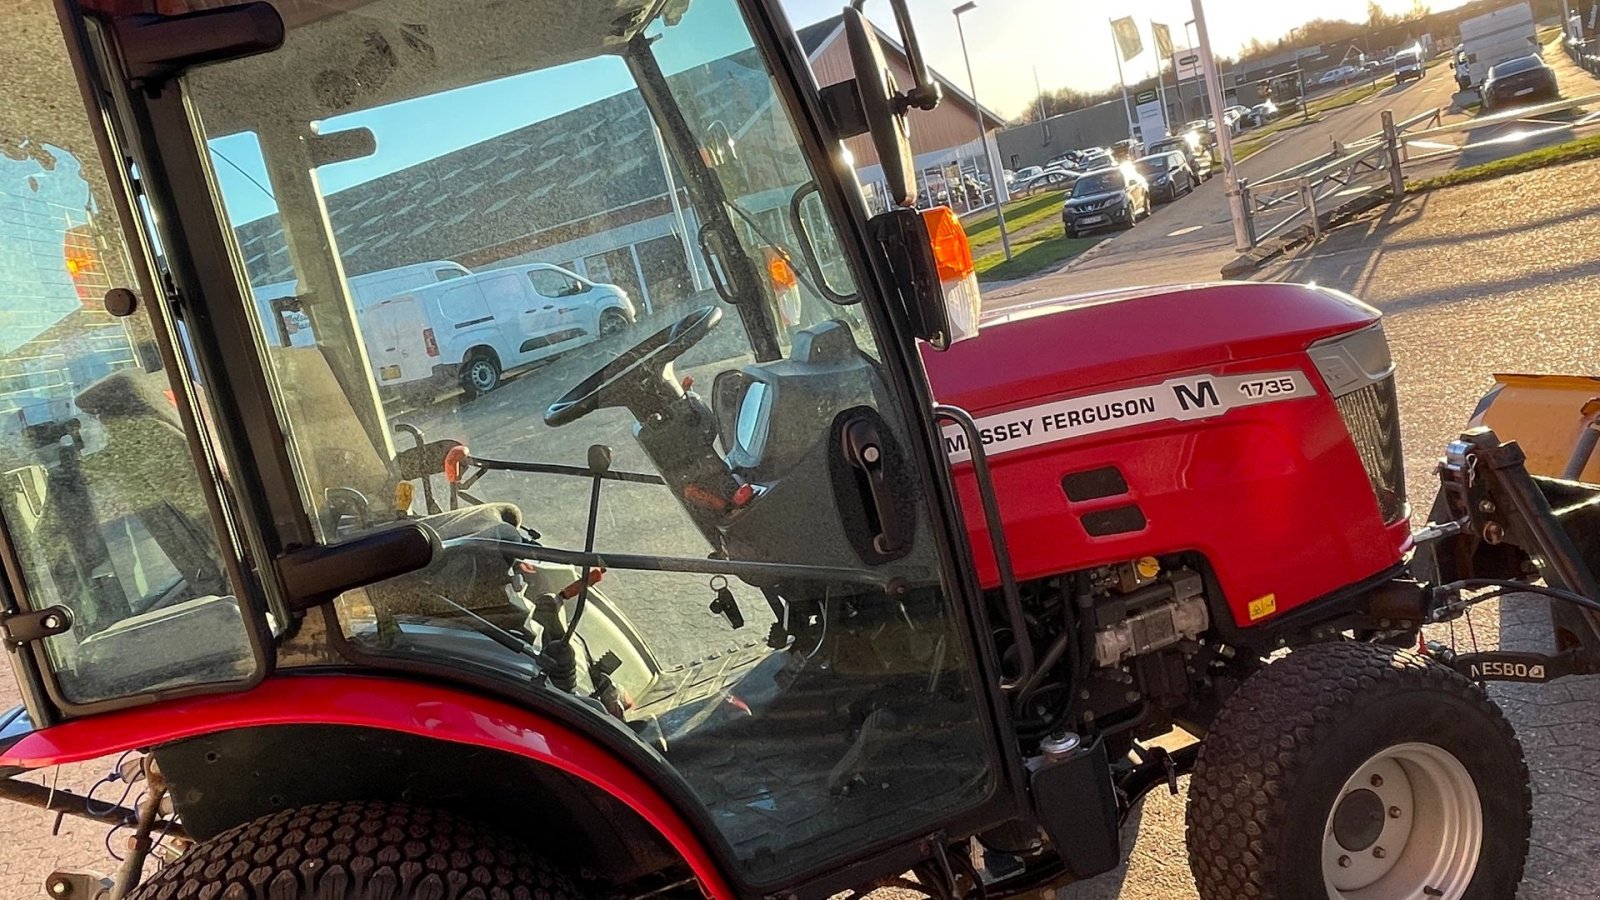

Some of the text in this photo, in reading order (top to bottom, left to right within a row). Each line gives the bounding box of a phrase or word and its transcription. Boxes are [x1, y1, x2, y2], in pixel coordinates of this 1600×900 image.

[945, 378, 1295, 453] MSSEY FERGUSON M 1735
